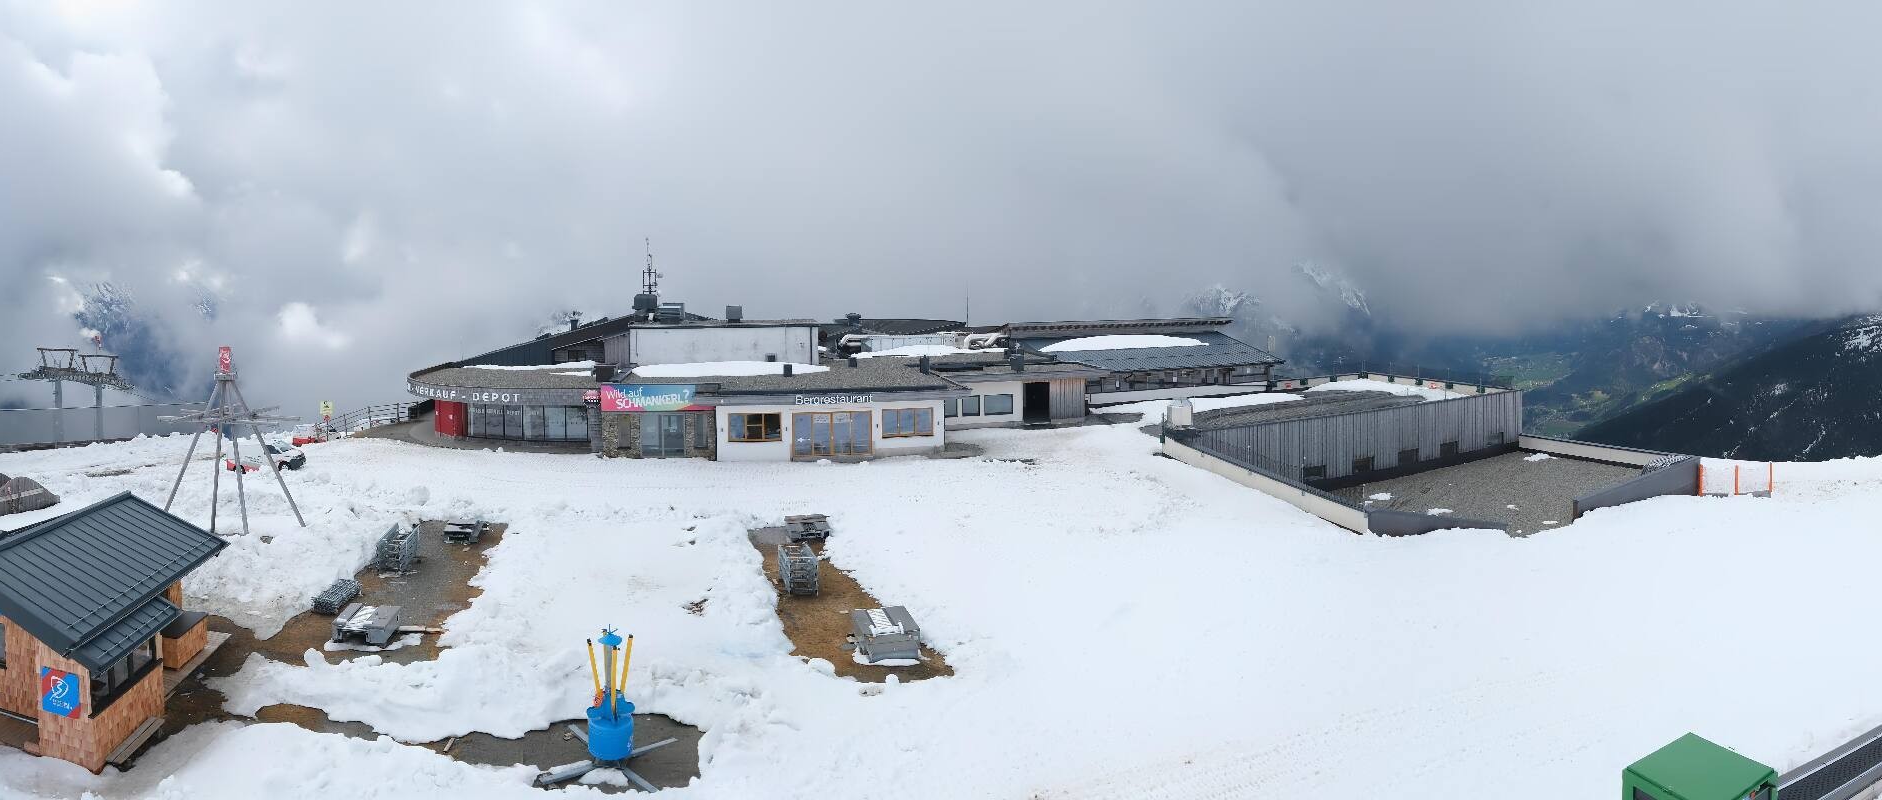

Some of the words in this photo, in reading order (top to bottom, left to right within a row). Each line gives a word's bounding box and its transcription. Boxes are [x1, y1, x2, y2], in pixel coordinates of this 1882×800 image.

[415, 385, 456, 400] VERKAUF
[472, 392, 521, 403] DEPOT
[606, 388, 626, 400] Wild
[628, 386, 644, 397] auf
[615, 389, 690, 409] SCHMANKERL?
[795, 394, 873, 405] Bergrestaurant
